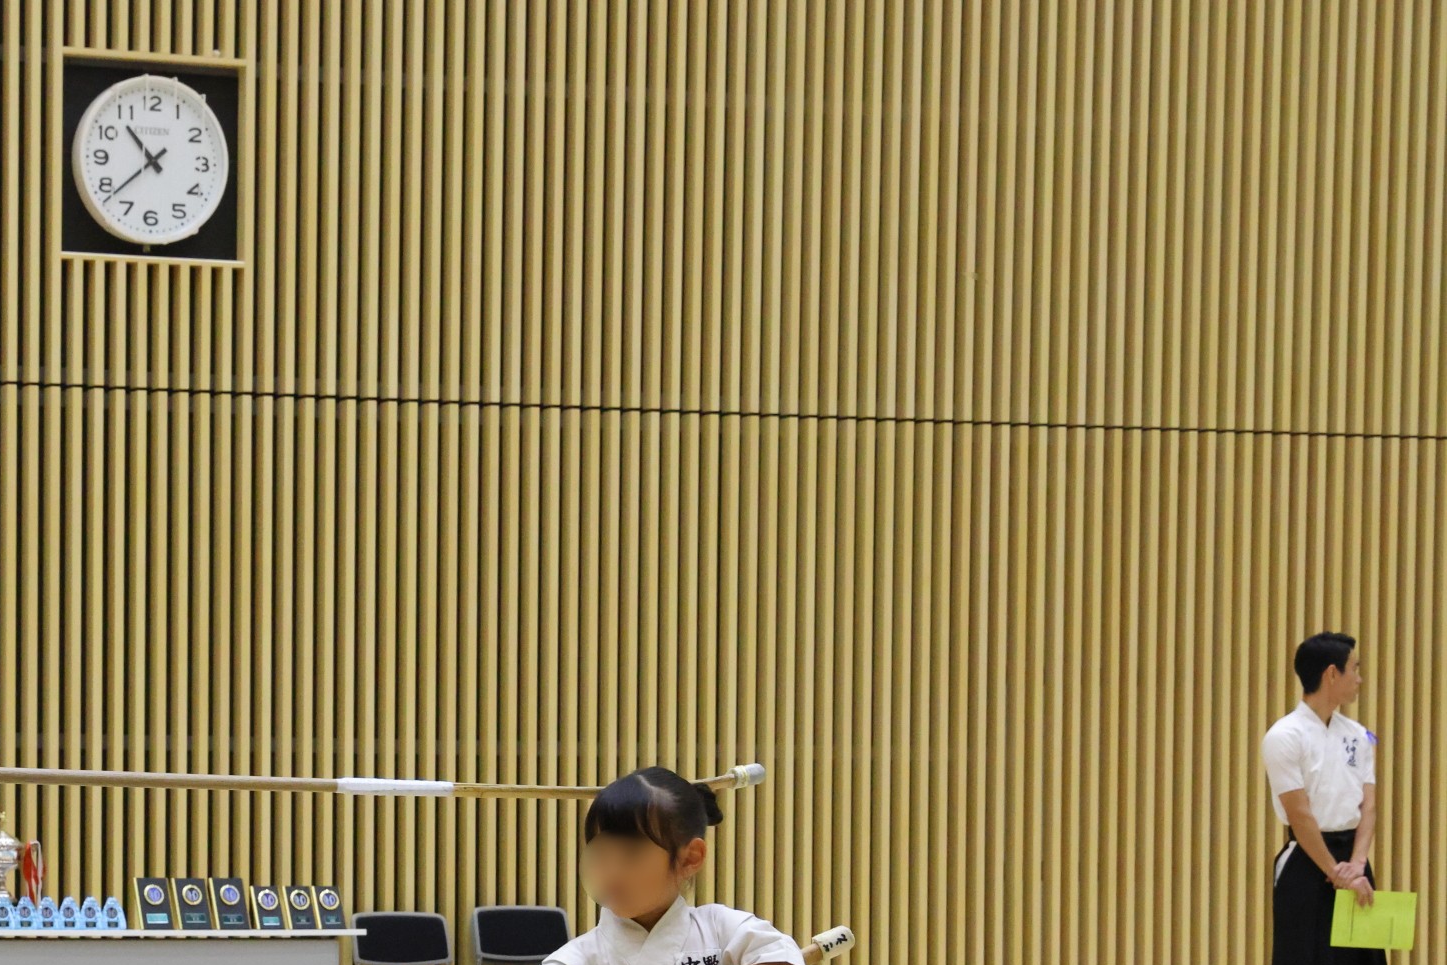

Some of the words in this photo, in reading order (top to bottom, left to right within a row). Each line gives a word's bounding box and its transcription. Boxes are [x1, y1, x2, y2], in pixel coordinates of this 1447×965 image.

[143, 95, 162, 112] 12
[175, 104, 180, 119] 1
[117, 104, 134, 120] 11
[98, 125, 118, 140] 10
[188, 127, 202, 143] 2
[93, 149, 109, 165] 9
[195, 156, 210, 172] 3
[98, 177, 114, 193] 8
[186, 183, 203, 197] 4
[119, 200, 134, 216] 7
[172, 203, 187, 219] 5
[143, 210, 158, 226] 6
